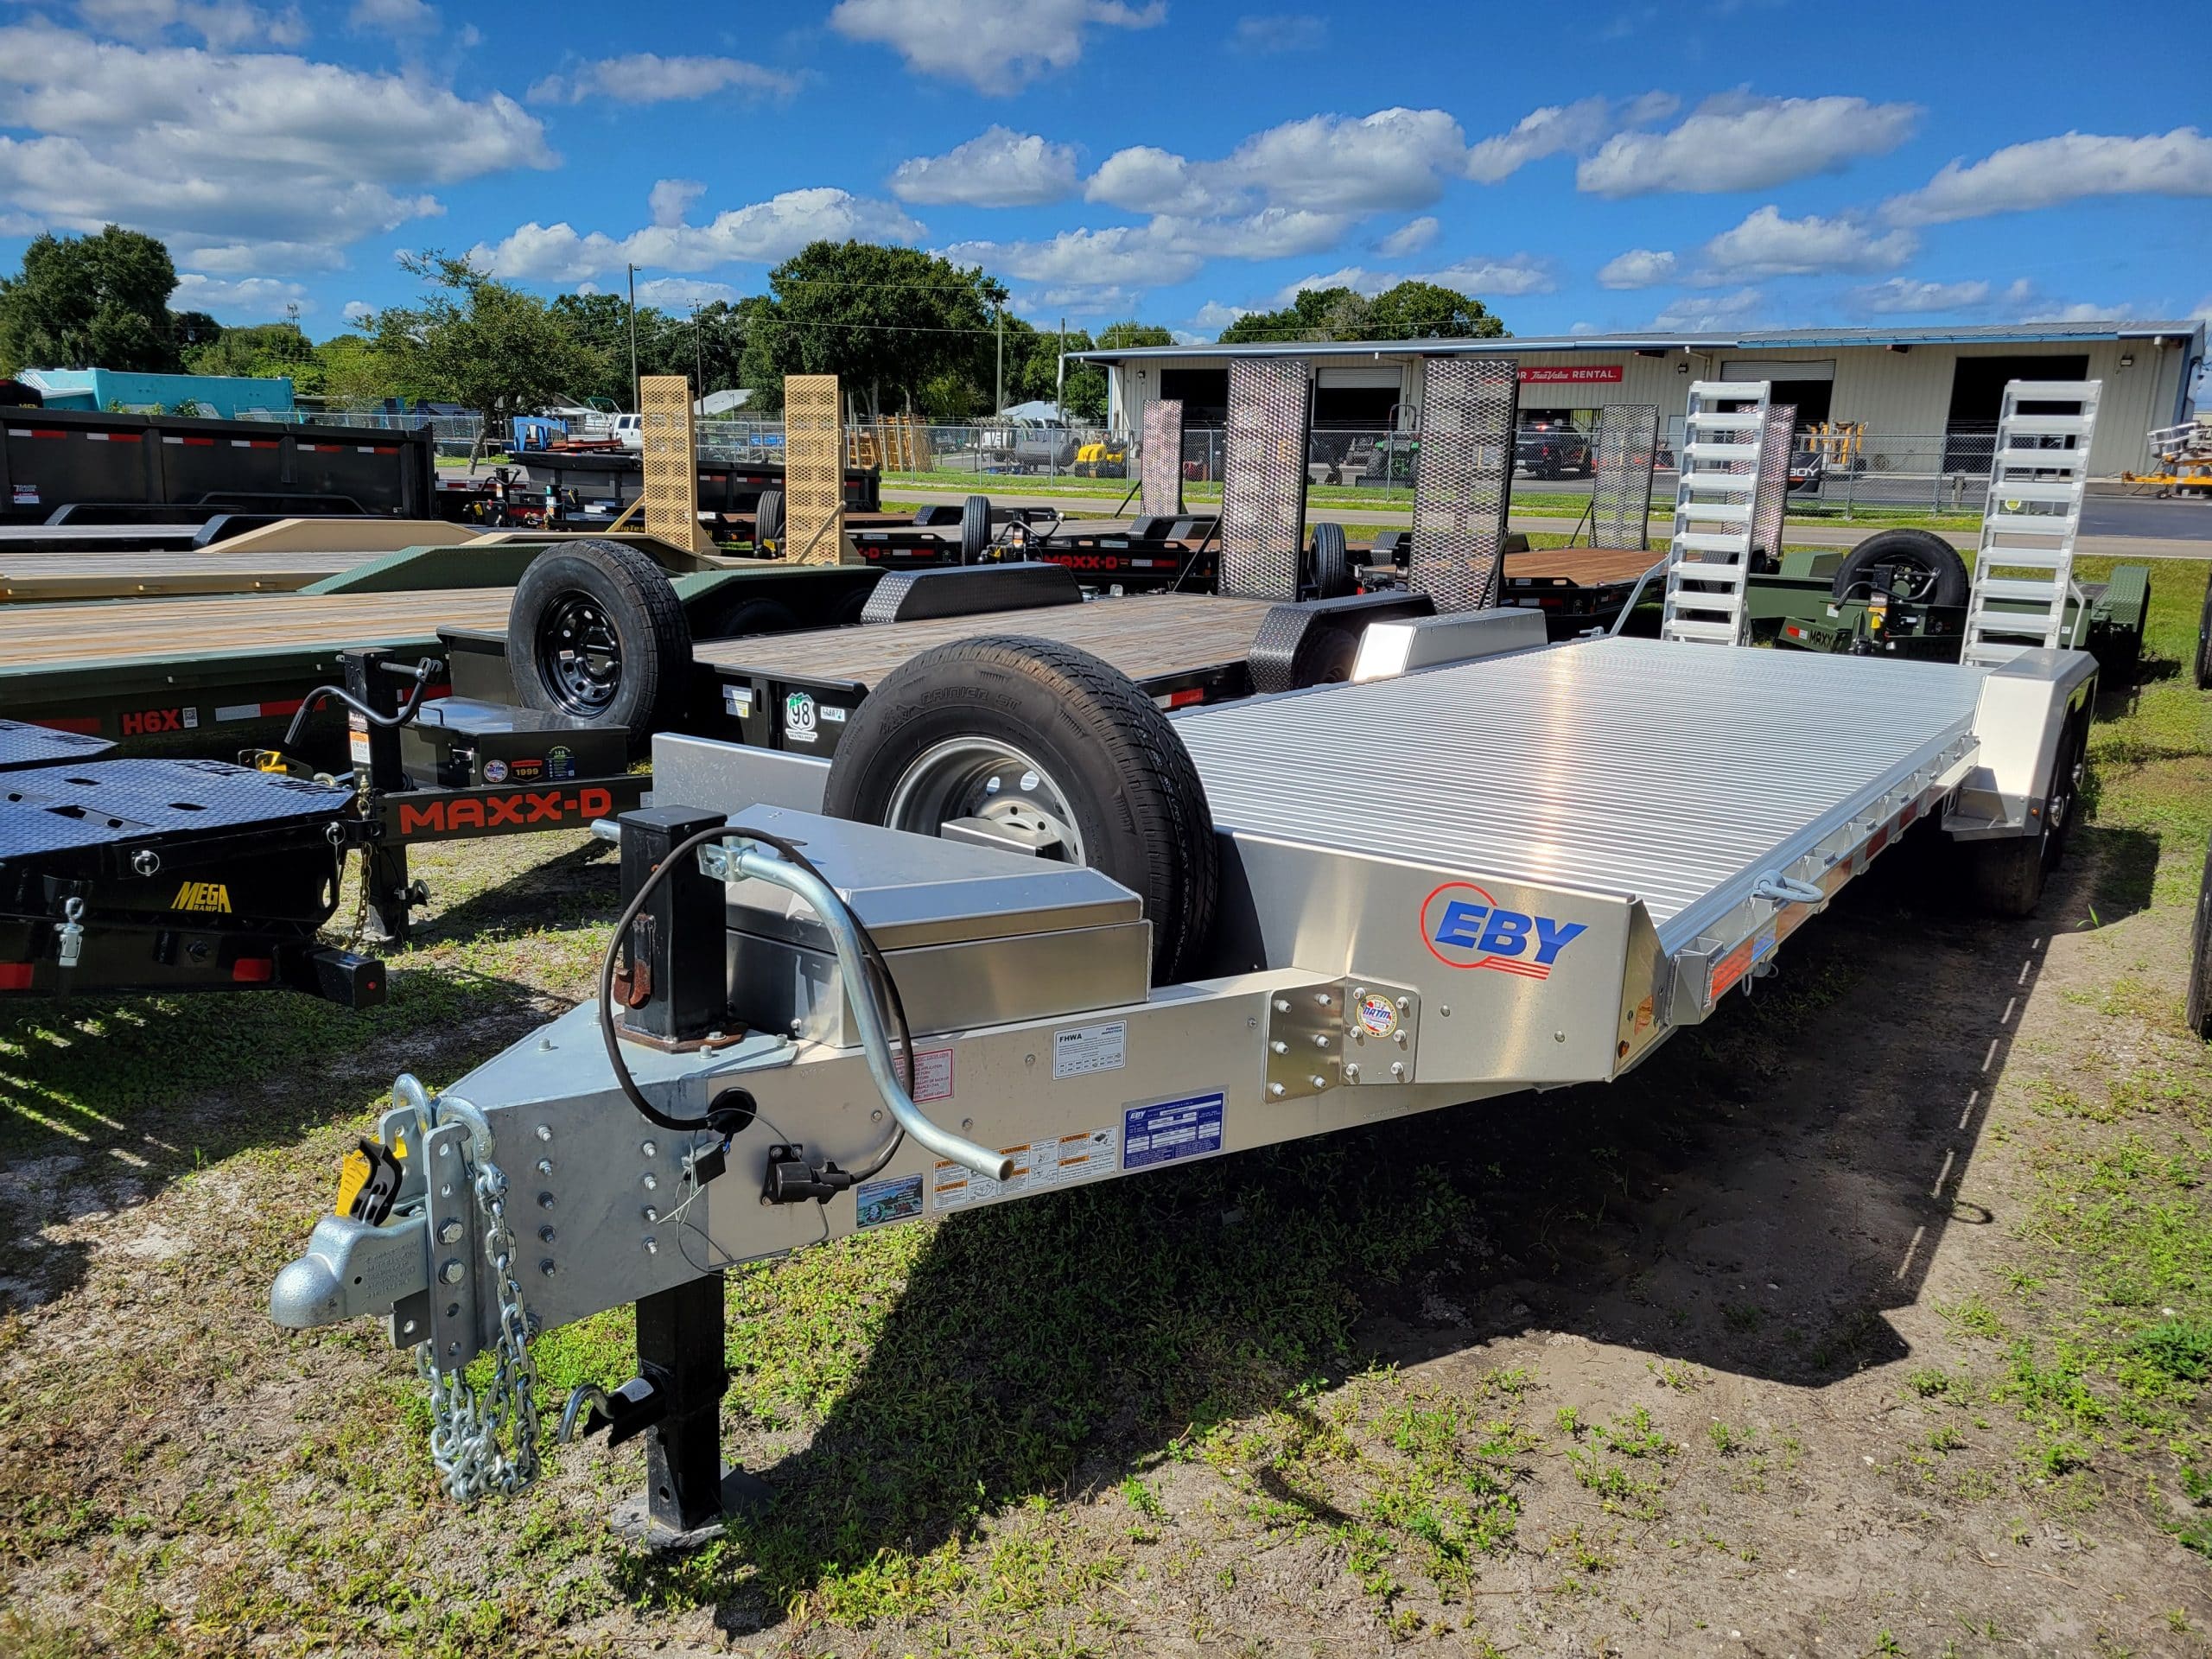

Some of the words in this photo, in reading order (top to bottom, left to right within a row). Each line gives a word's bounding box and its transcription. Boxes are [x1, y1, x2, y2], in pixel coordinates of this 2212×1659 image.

[123, 709, 181, 736] H6X
[792, 702, 810, 726] 98
[399, 788, 612, 835] MAXX-D
[170, 881, 232, 912] MEGA
[1434, 900, 1590, 965] EBY
[1059, 1033, 1083, 1043] FHWA
[1130, 1110, 1146, 1119] EBY
